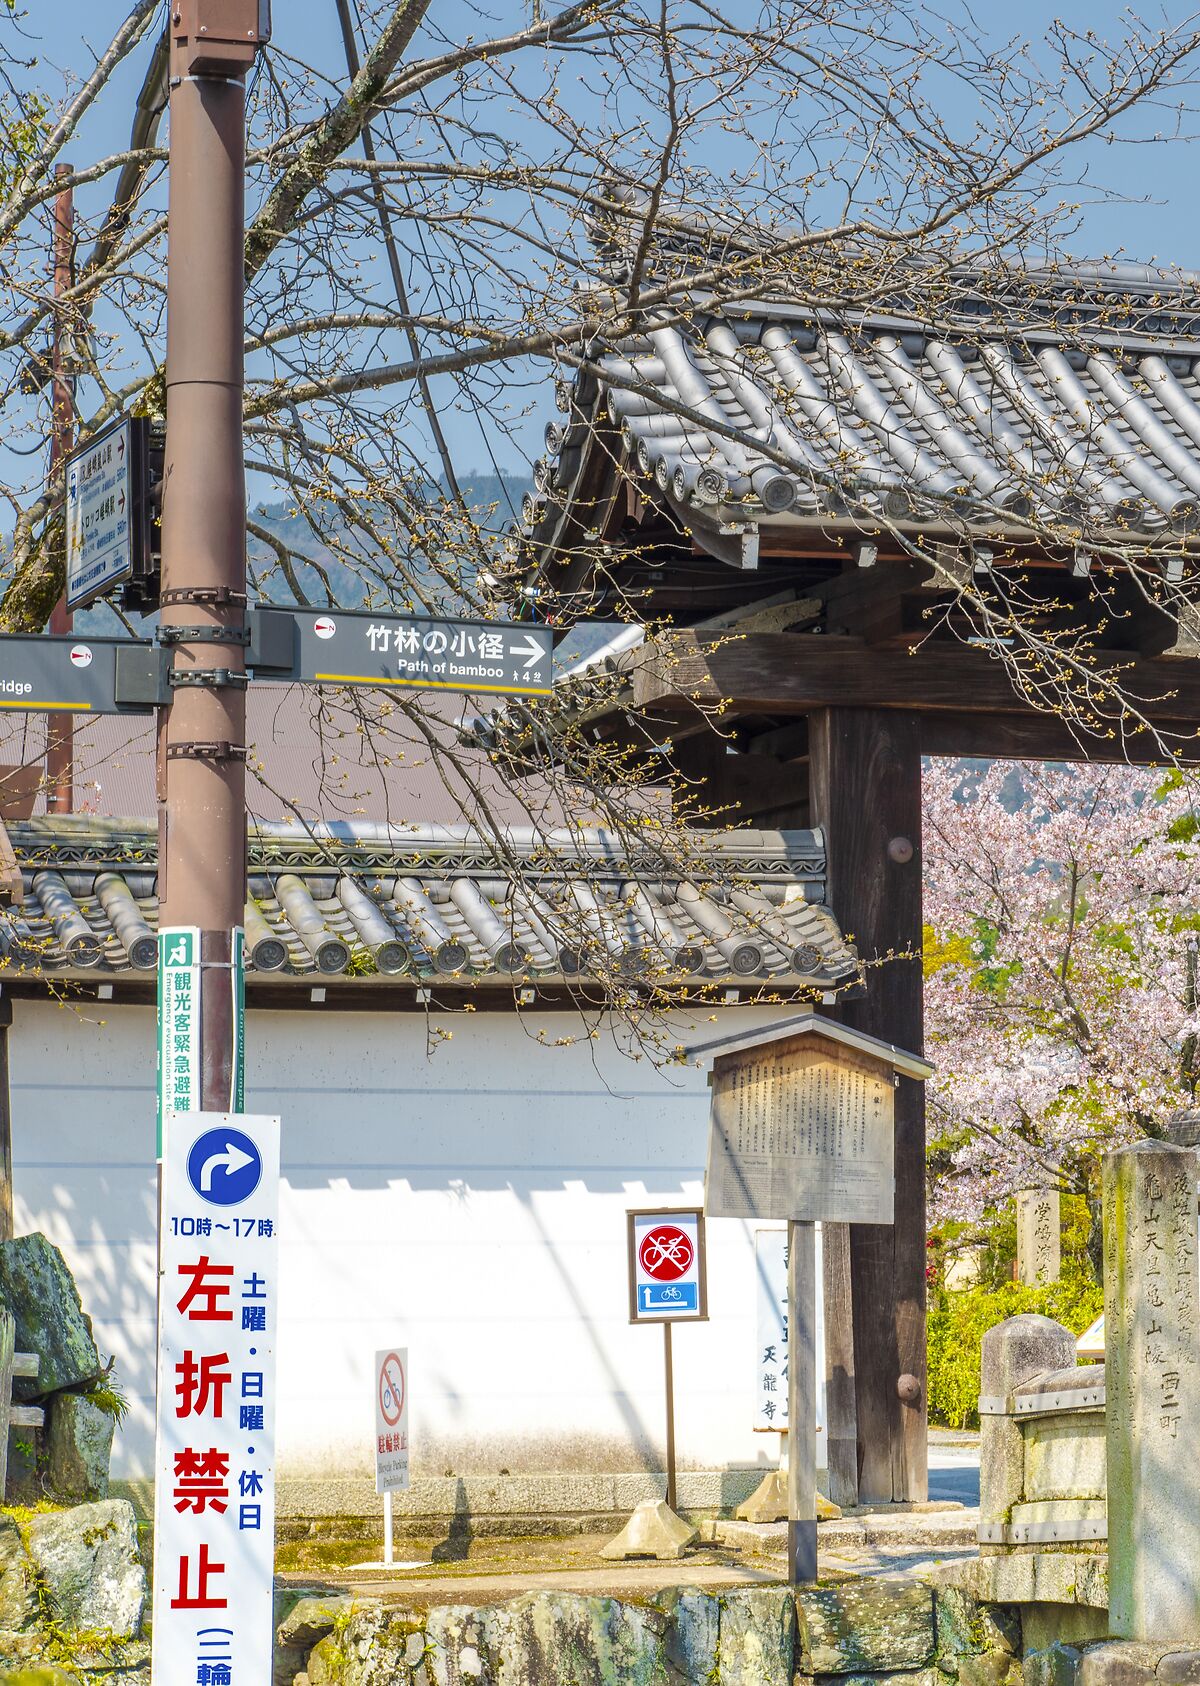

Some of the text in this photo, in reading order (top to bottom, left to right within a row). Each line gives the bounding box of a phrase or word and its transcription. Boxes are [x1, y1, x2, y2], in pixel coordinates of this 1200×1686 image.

[365, 624, 504, 660] 竹林の小径
[398, 659, 504, 678] Path of bamboo
[165, 973, 173, 1024] Emergency
[174, 973, 191, 1111] 観光客緊急避難
[238, 1272, 267, 1530] 土曜・日曜・休日
[761, 1345, 778, 1420] 天龍寺
[170, 1255, 234, 1609] 左折禁止
